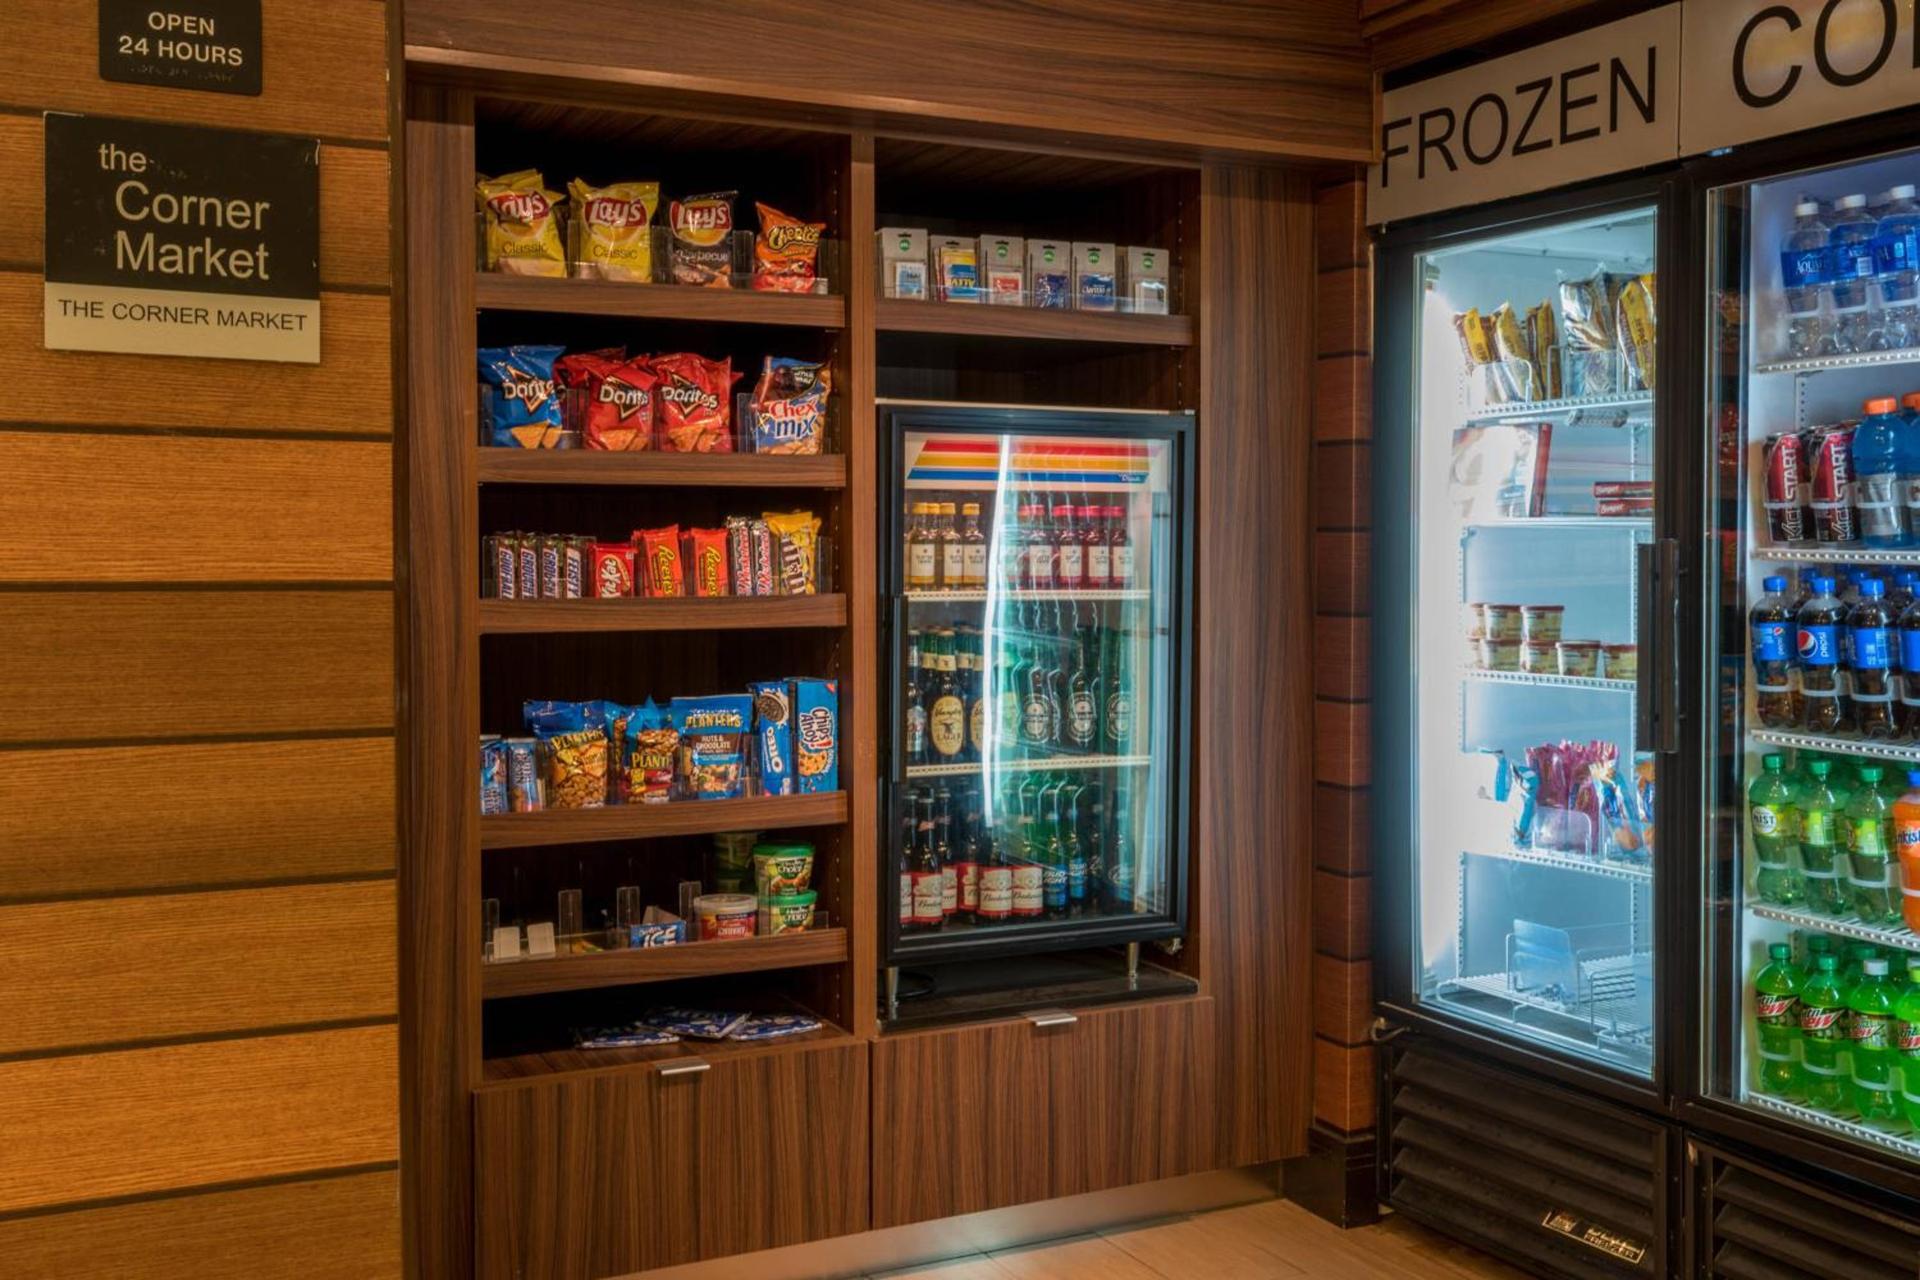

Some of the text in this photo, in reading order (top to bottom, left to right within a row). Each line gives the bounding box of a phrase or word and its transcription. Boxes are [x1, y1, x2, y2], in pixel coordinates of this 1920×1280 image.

[148, 12, 215, 36] OPEN
[119, 36, 243, 66] 24 HOURS
[1382, 46, 1656, 188] FROZEN
[98, 143, 147, 173] the
[115, 180, 270, 230] Corner
[116, 230, 269, 281] Market
[502, 241, 549, 258] Classic
[58, 299, 307, 332] THE CORNER MARKET
[661, 386, 718, 408] Doritos
[769, 399, 818, 418] Chex
[776, 415, 818, 438] mix
[521, 551, 536, 597] GROUCH
[812, 709, 829, 742] Chips
[767, 727, 783, 773] OREO
[643, 925, 678, 948] ICE
